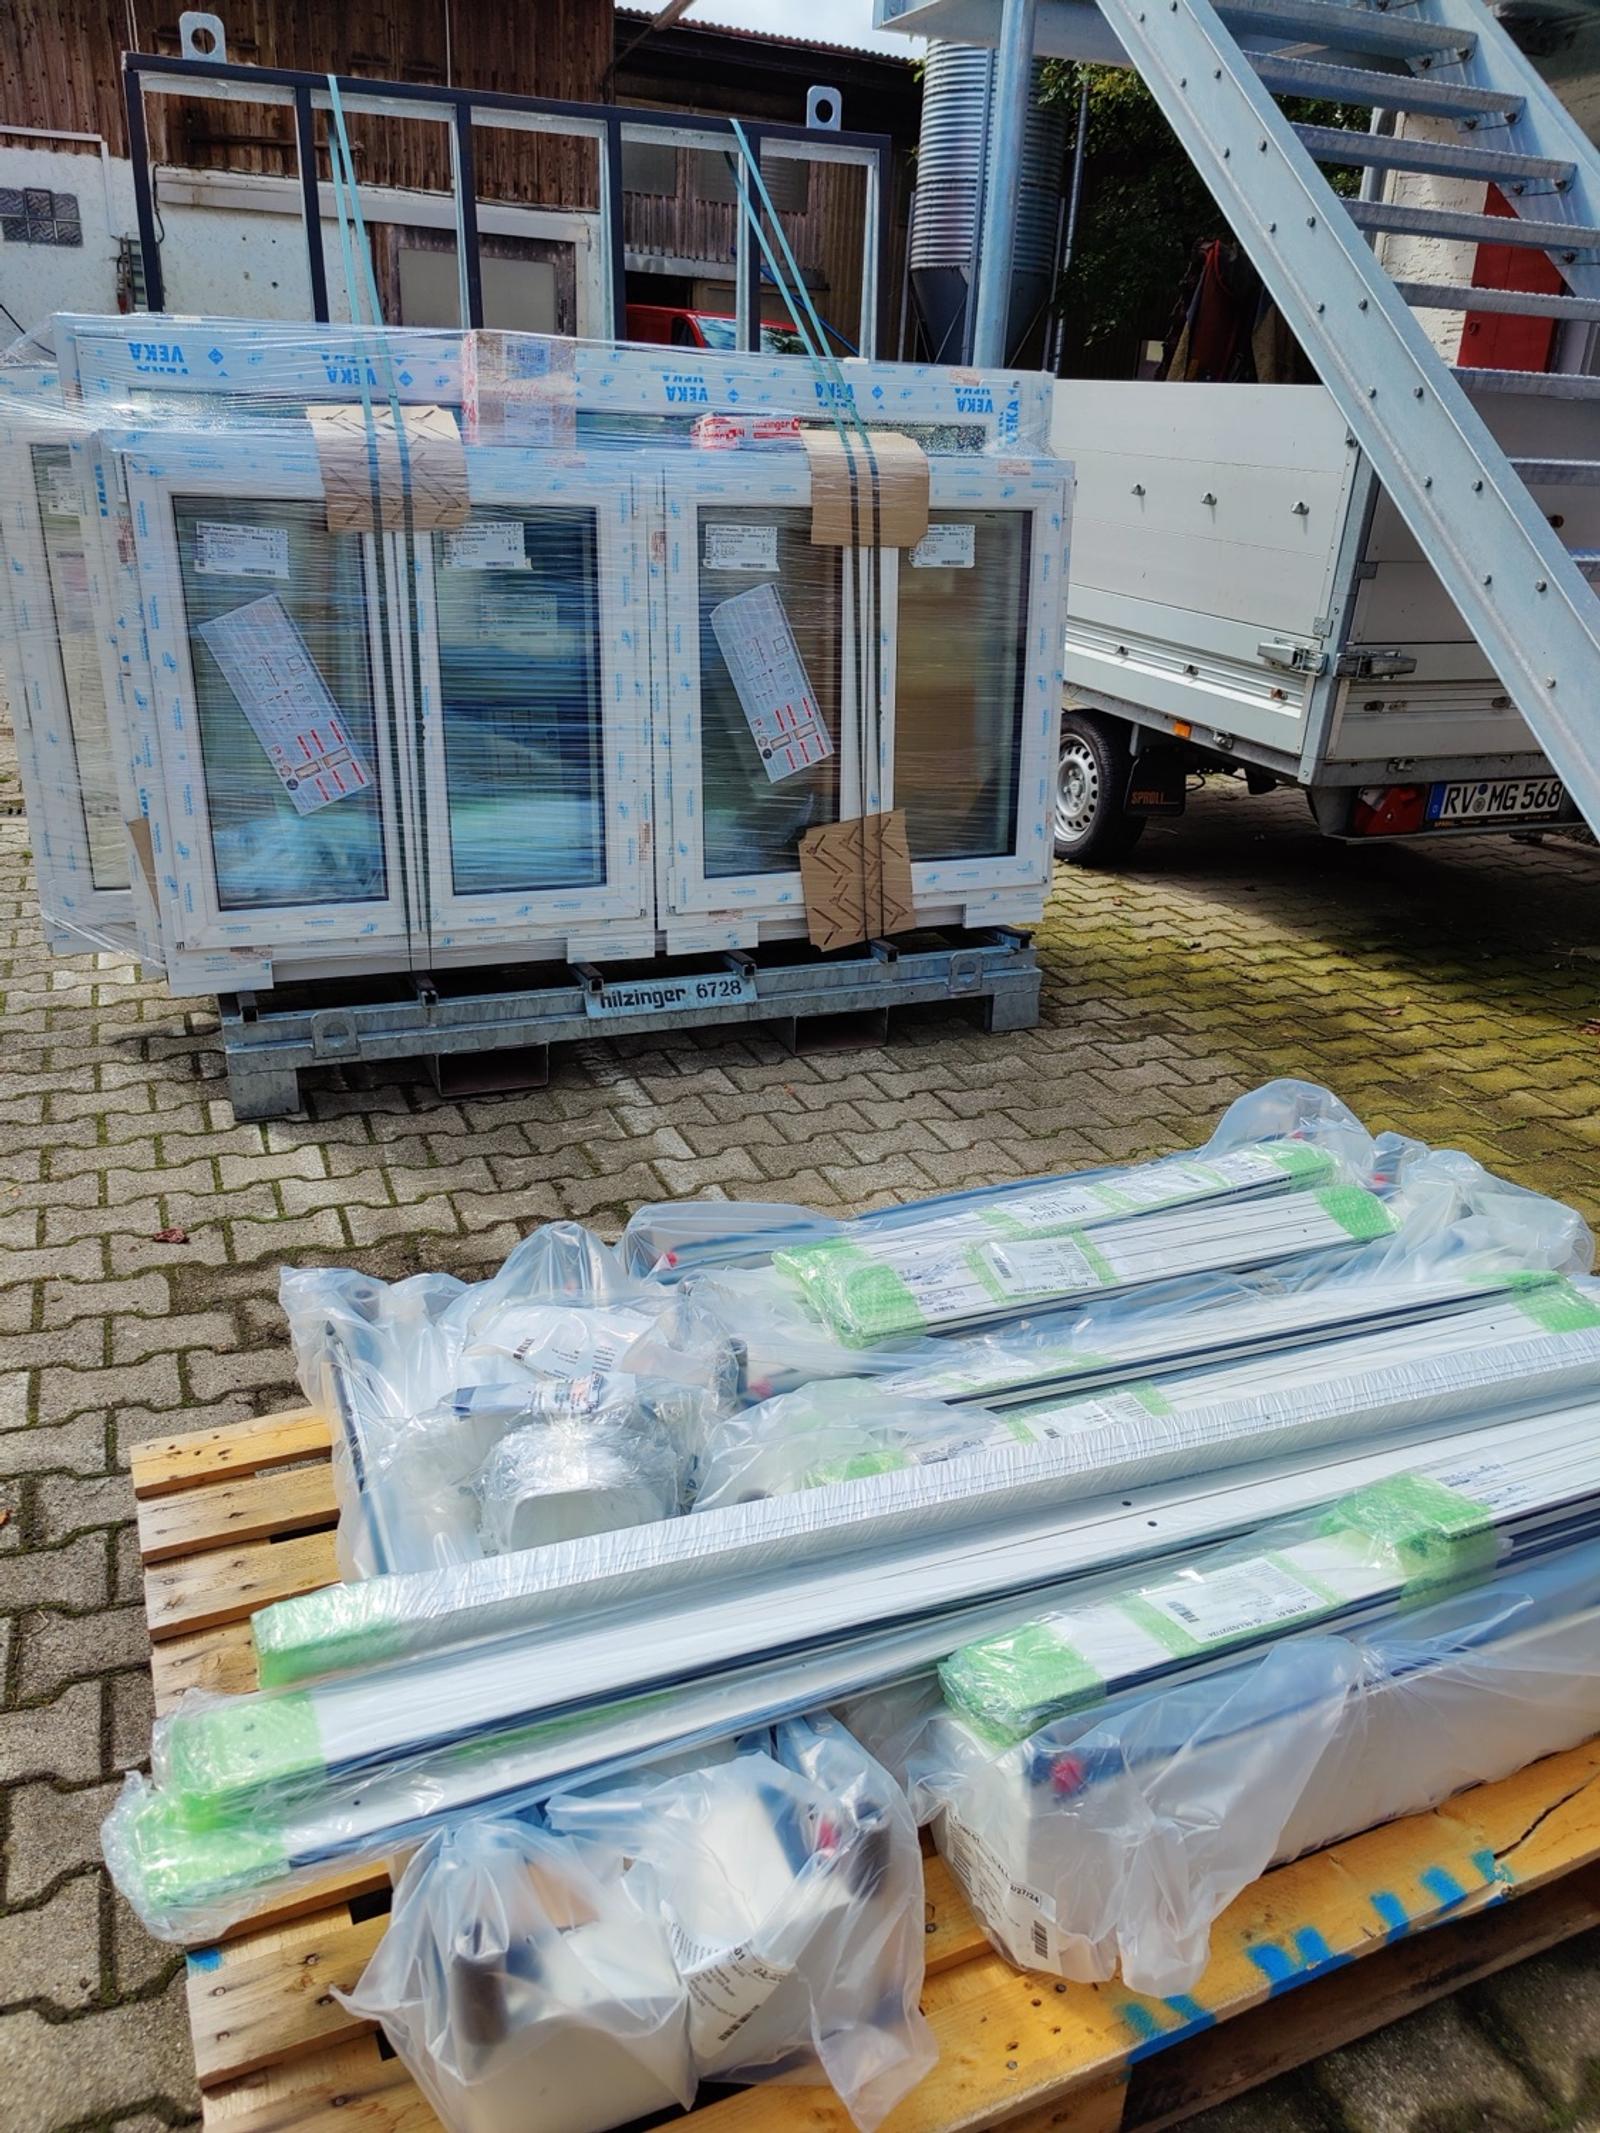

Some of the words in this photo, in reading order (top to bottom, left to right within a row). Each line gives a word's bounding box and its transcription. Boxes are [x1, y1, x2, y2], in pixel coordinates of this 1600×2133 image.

[128, 342, 184, 363] VEKA
[326, 366, 377, 386] VEKA
[666, 386, 708, 402] VEKA
[957, 397, 994, 413] VEKA
[1443, 786, 1478, 814] RV
[1487, 783, 1519, 812] MG
[1521, 781, 1563, 809] 568
[601, 987, 686, 1009] hilzinger
[696, 980, 742, 998] 6728
